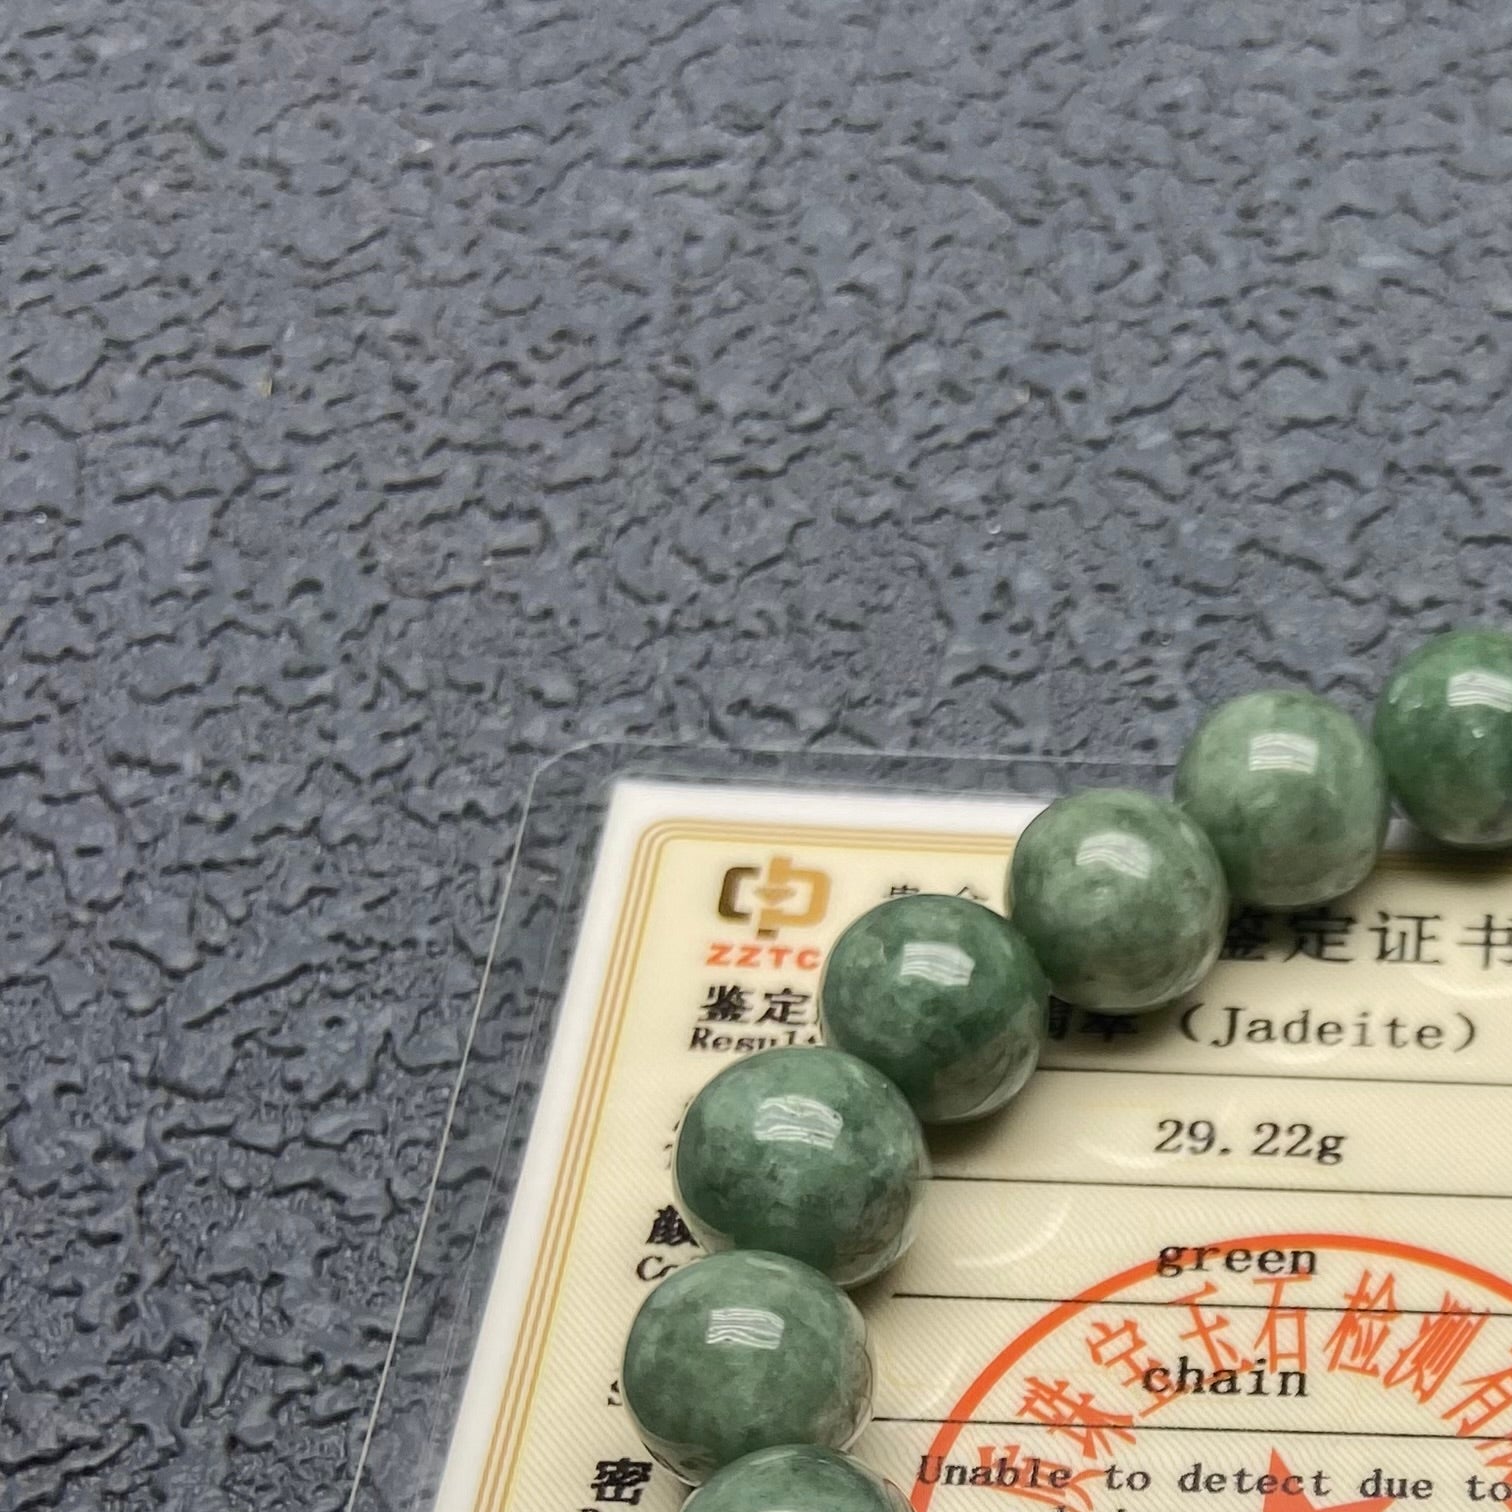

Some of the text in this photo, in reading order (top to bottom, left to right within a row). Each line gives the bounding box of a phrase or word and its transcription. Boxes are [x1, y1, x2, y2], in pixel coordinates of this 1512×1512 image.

[705, 941, 822, 971] ZZTC
[697, 984, 820, 1025] 鉴定
[1153, 1118, 1347, 1166] 29.22g
[1155, 1244, 1318, 1278] green
[1141, 1356, 1308, 1398] chain
[917, 1454, 1073, 1489] Unable
[1104, 1463, 1152, 1491] to
[1178, 1463, 1331, 1495] detect
[1359, 1468, 1434, 1500] due
